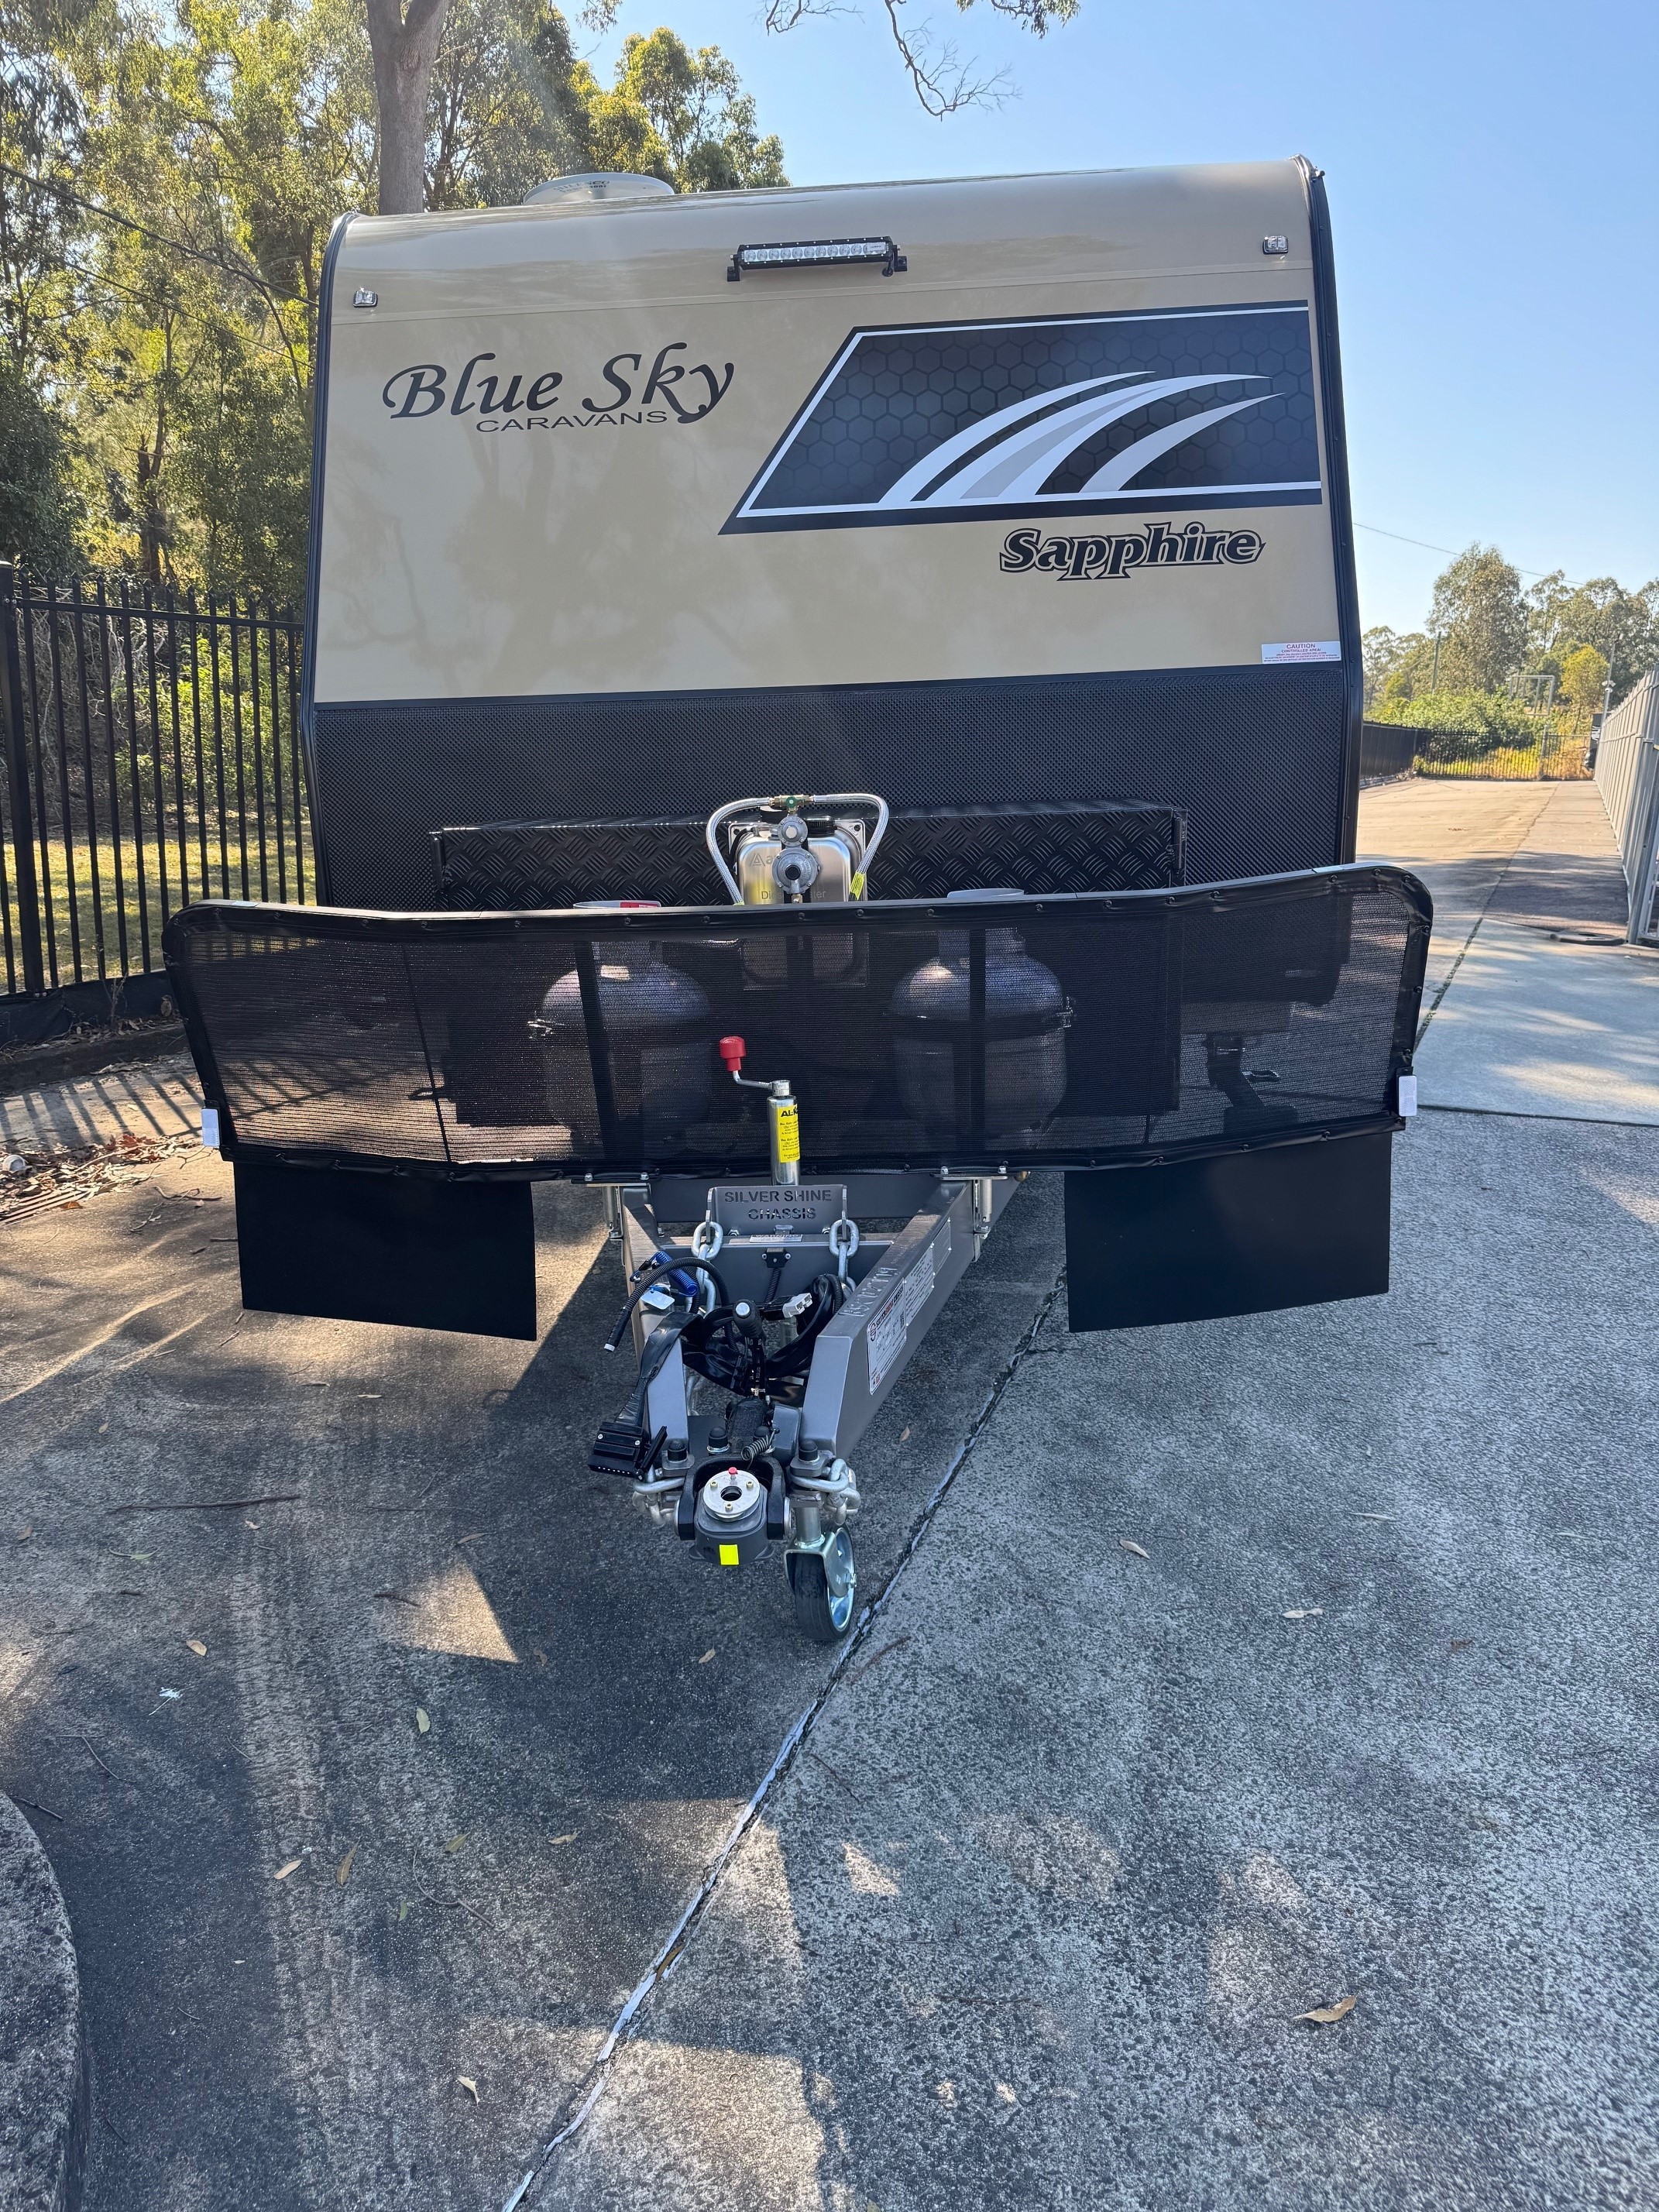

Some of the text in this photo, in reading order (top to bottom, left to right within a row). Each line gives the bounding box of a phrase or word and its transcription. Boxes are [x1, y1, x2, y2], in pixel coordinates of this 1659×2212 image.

[383, 342, 734, 424] Blue Sky
[476, 410, 668, 432] CARAVANS
[1000, 521, 1266, 581] Sapphire
[724, 1190, 832, 1203] SILVER SHINE
[748, 1207, 816, 1220] CHASSIS
